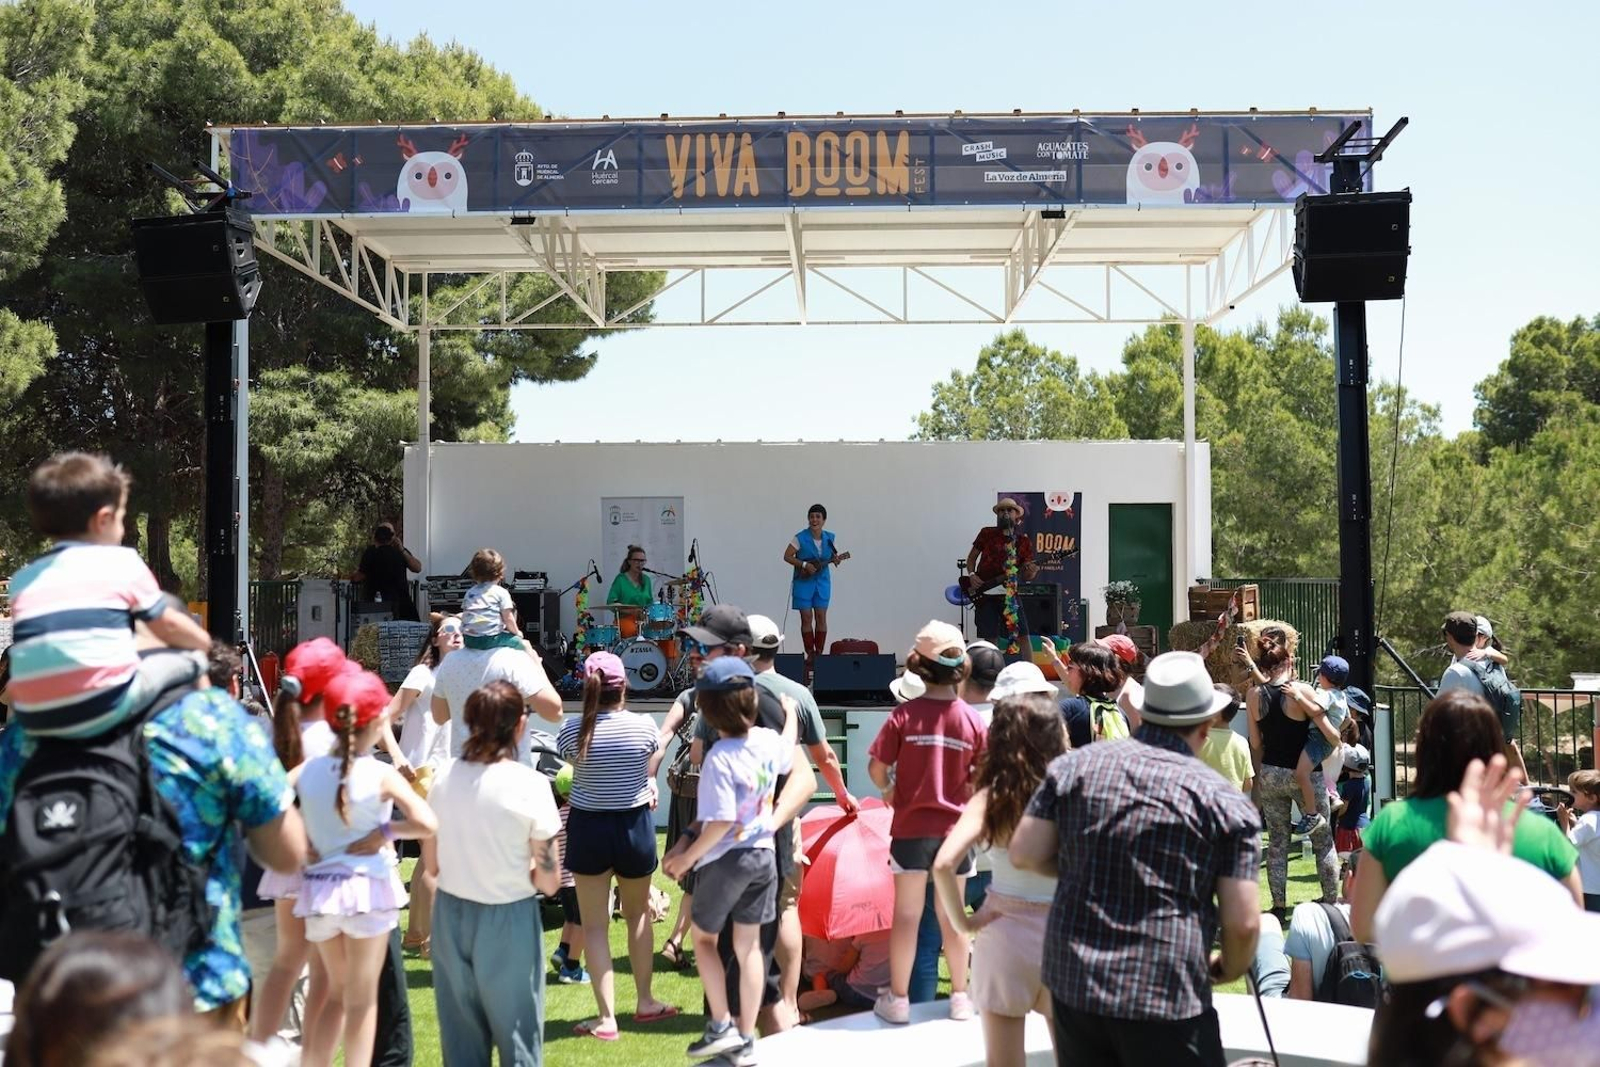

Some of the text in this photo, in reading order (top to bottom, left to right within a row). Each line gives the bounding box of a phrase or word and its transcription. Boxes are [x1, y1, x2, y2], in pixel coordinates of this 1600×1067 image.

[964, 144, 991, 152] CRASH
[1037, 142, 1089, 151] AGUACATES
[978, 151, 1004, 160] MUSIC
[1052, 151, 1089, 160] TOMATE
[665, 130, 910, 199] VIVA BOOM
[591, 171, 618, 179] Huércal
[914, 157, 926, 194] FEST
[986, 173, 997, 181] La
[1016, 173, 1027, 181] de
[1028, 172, 1065, 181] Almería
[1036, 532, 1075, 553] BOOM
